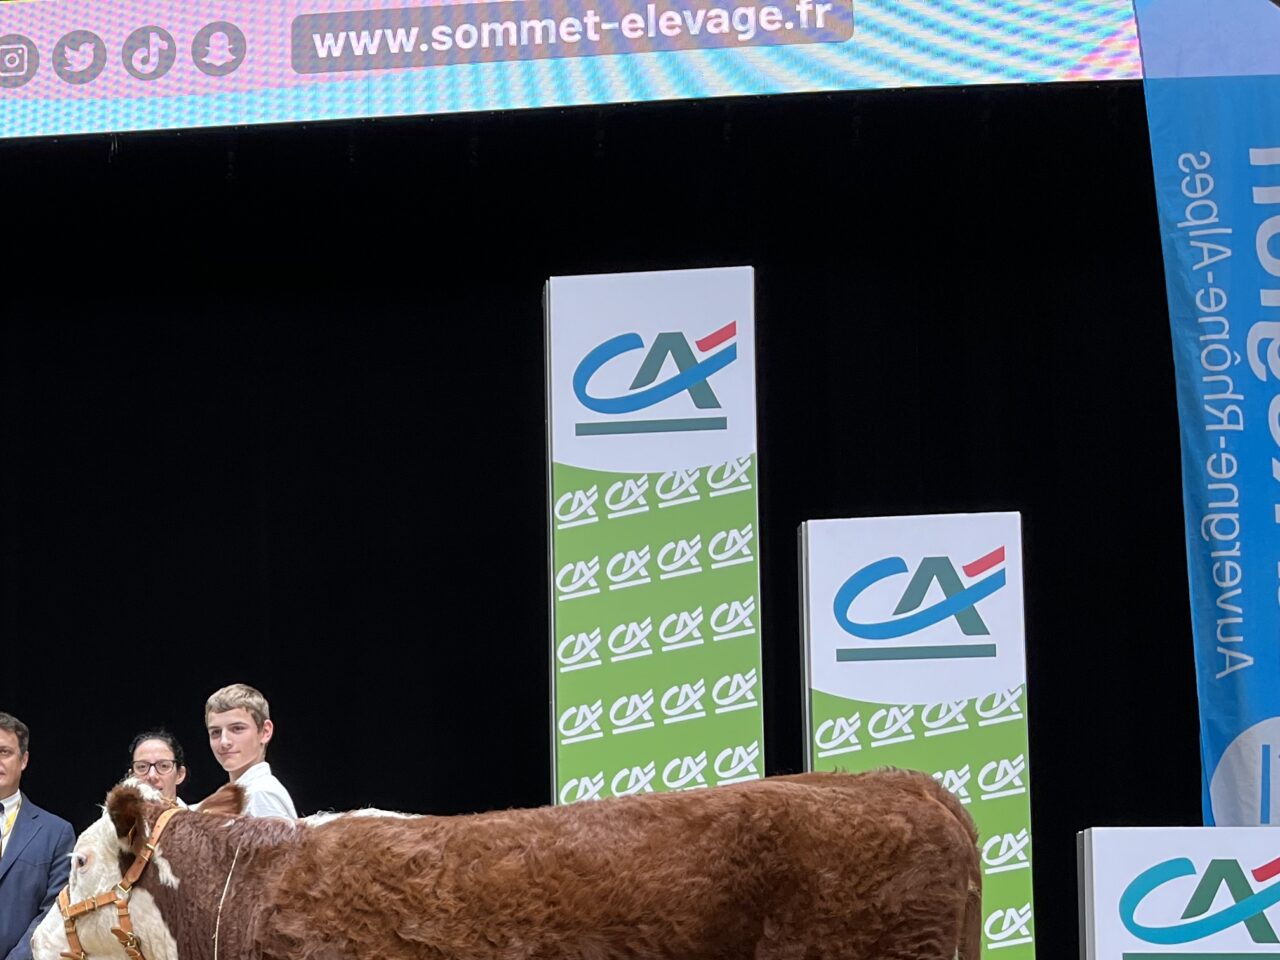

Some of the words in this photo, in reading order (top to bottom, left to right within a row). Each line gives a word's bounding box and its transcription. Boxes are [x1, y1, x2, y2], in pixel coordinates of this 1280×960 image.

[311, 0, 832, 58] www.sommet-elevage.fr
[572, 319, 738, 415] CA
[832, 544, 1007, 641] CA
[1118, 856, 1280, 945] CA
